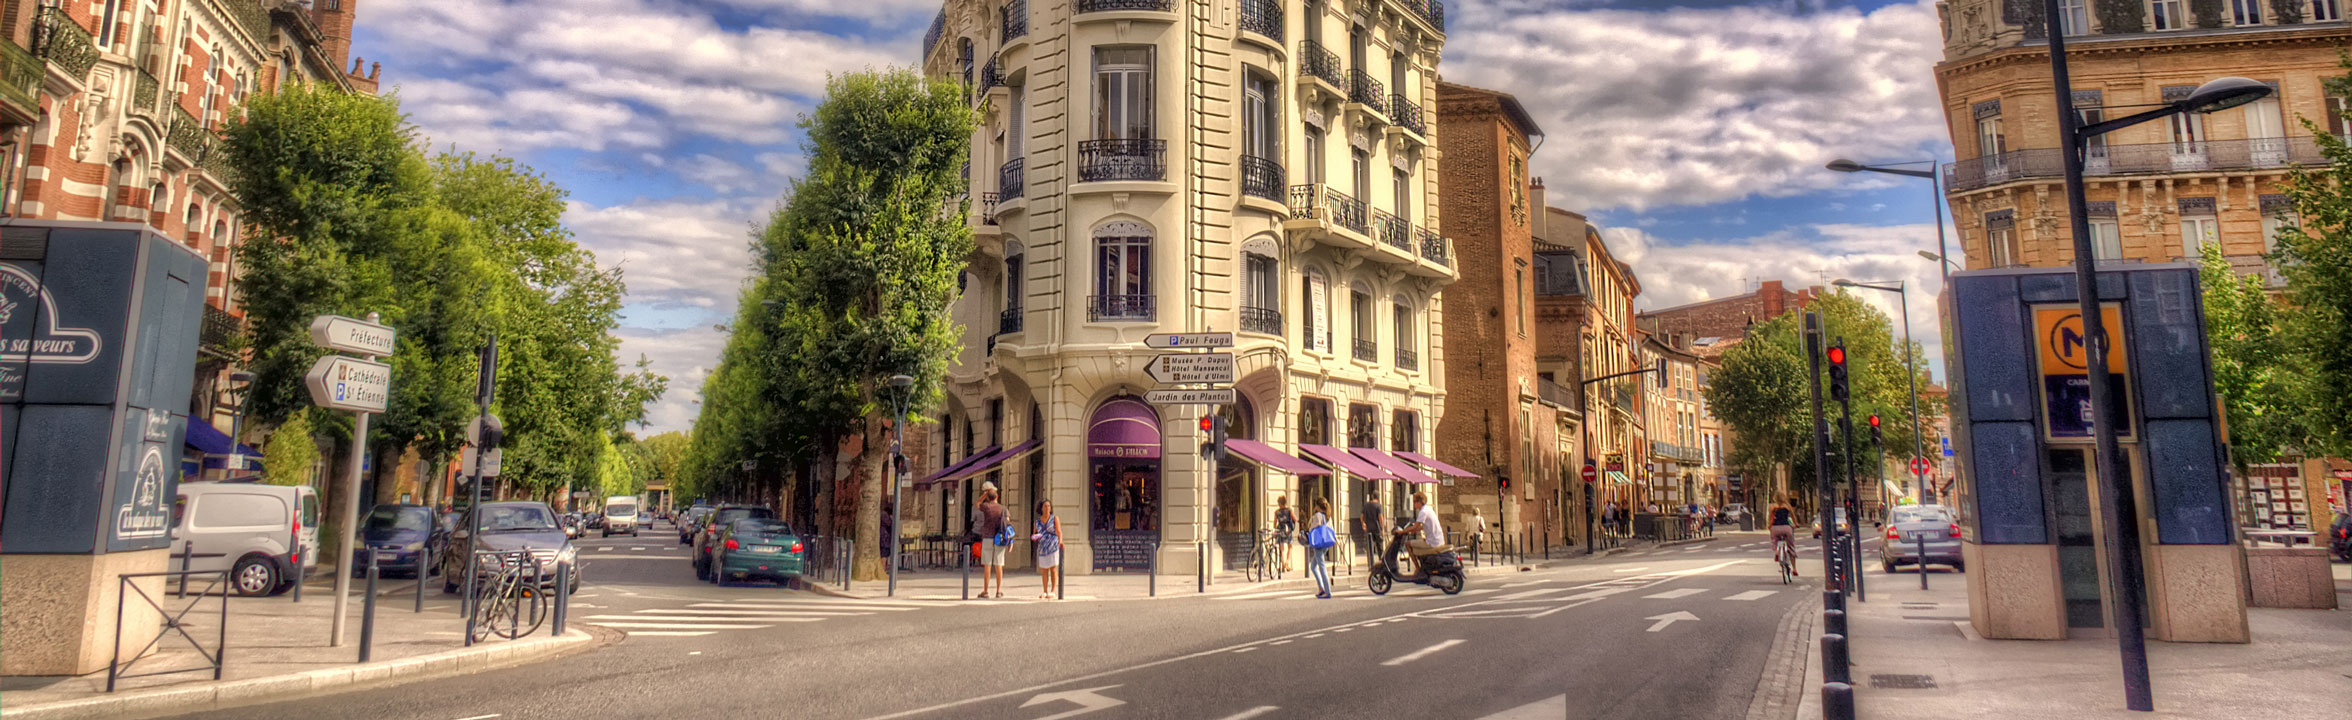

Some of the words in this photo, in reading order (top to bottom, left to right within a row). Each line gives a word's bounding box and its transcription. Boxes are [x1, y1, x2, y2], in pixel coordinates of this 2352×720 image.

[10, 338, 76, 353] saveurs
[351, 328, 391, 348] Préfecture
[1180, 336, 1199, 344] Paul
[1204, 336, 1230, 345] Feuga
[348, 367, 387, 387] Cathédrale
[357, 384, 385, 403] Étienne
[1153, 393, 1178, 401] Jardin
[1182, 393, 1195, 401] des
[1200, 393, 1230, 401] Plantes
[1095, 447, 1114, 456] Maison
